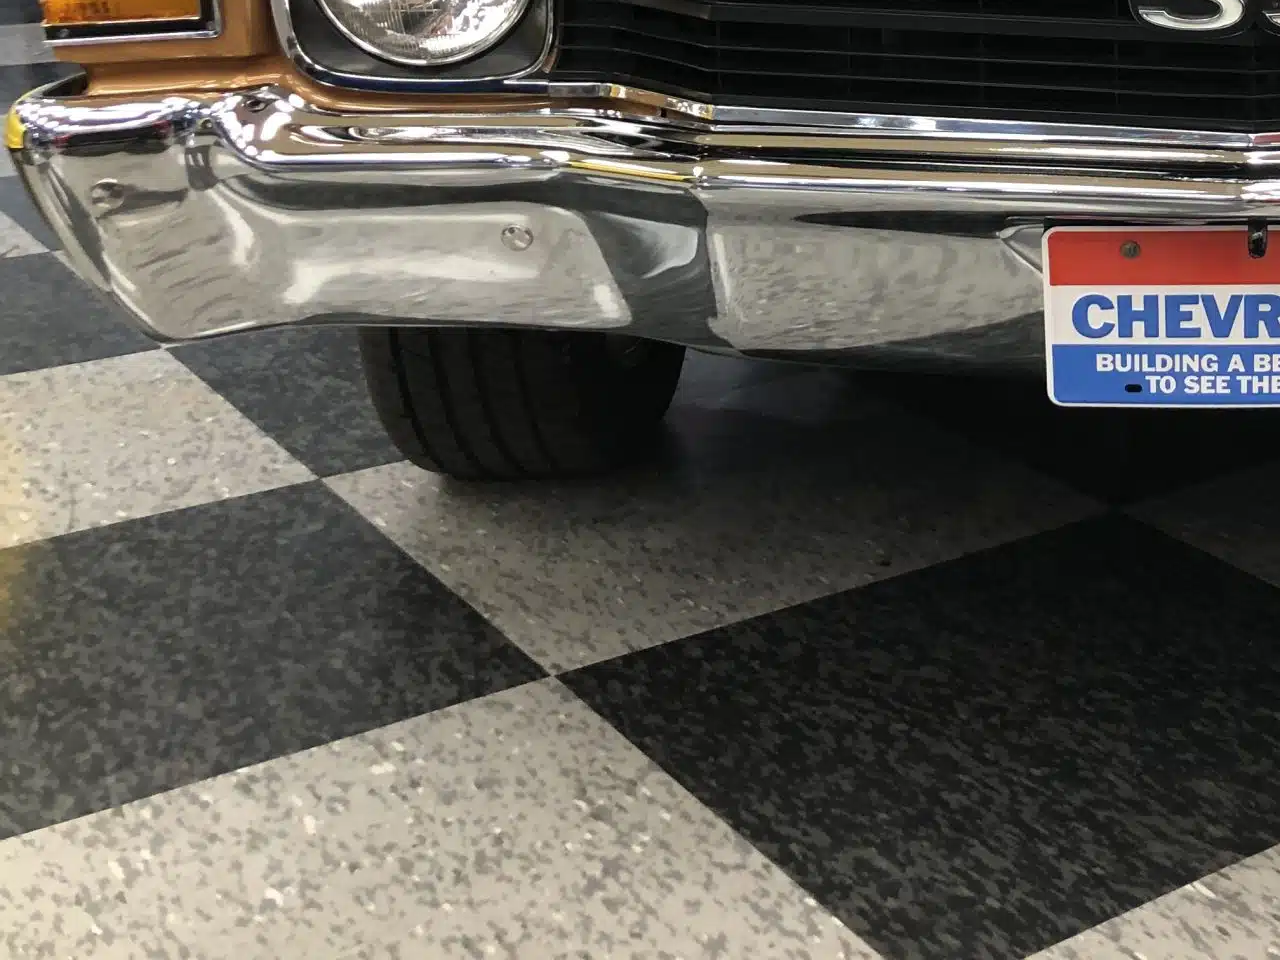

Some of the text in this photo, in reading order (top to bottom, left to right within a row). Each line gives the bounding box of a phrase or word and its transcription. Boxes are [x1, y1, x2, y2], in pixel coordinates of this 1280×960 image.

[1096, 353, 1218, 373] BUILDING
[1227, 354, 1245, 372] A
[1145, 375, 1176, 394] TO
[1183, 375, 1231, 394] SEE
